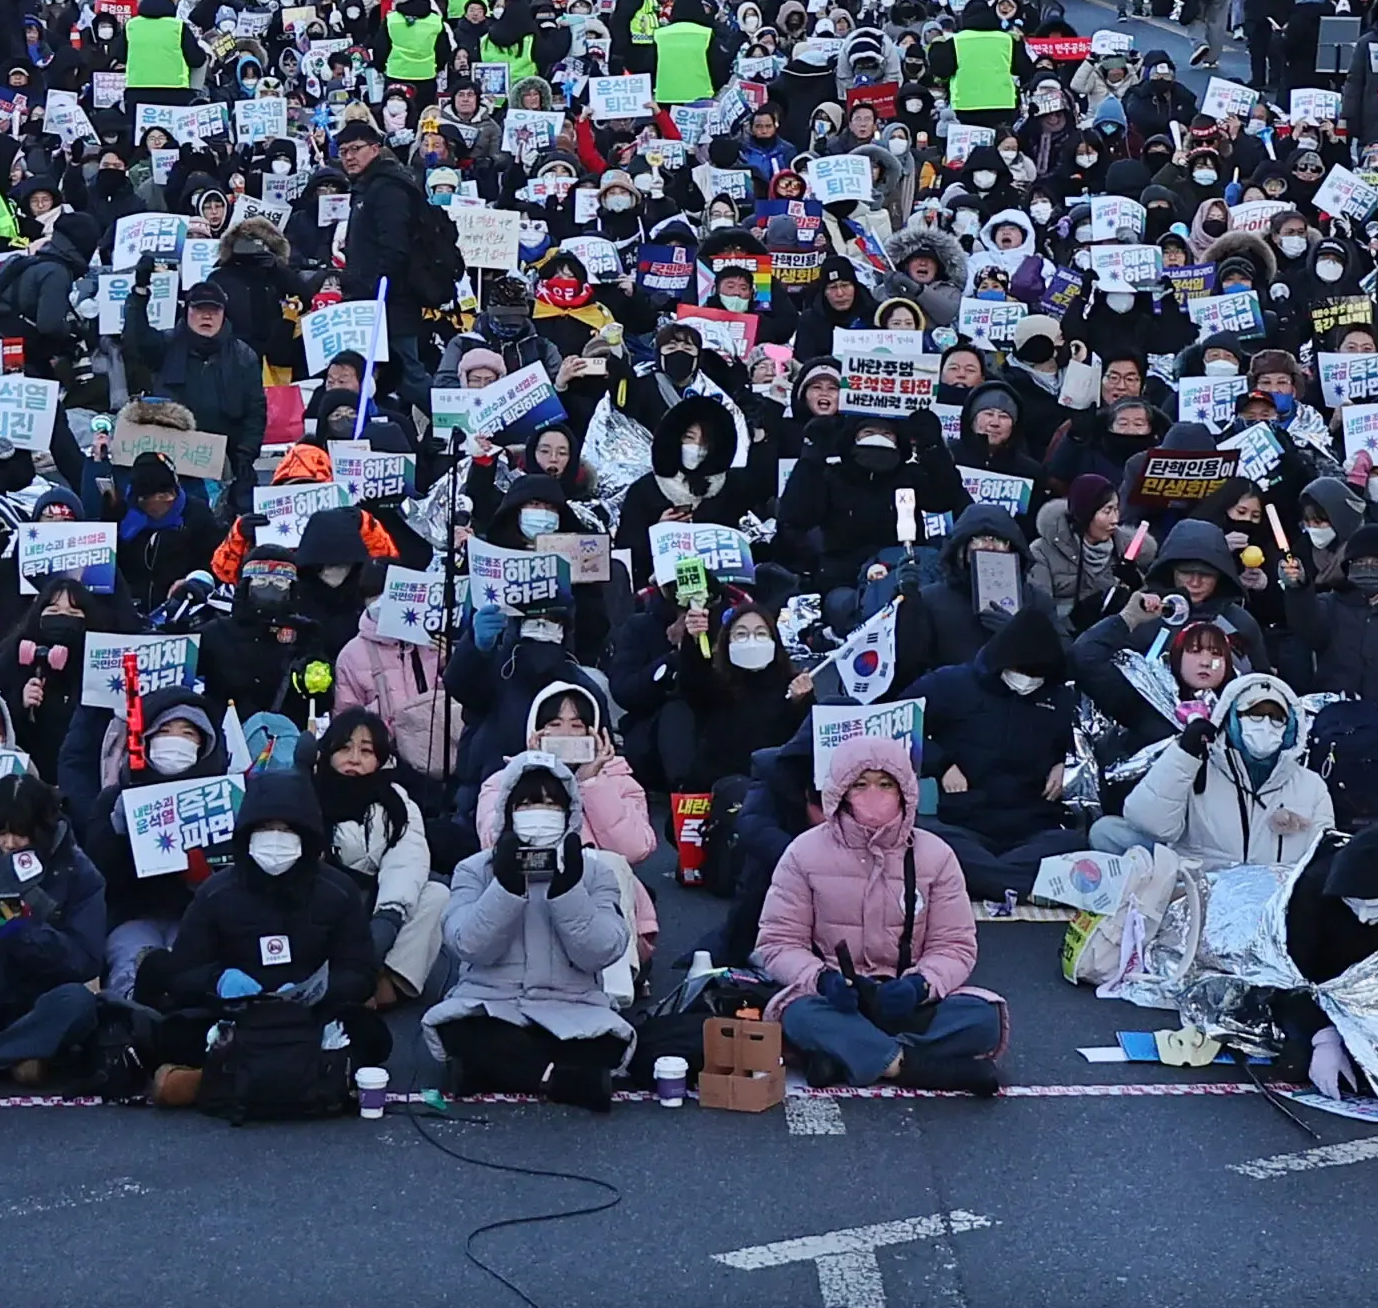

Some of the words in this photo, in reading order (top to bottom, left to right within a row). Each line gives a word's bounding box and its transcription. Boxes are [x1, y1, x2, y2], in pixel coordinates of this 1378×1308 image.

[595, 78, 644, 95] 윤석열
[604, 95, 637, 114] 퇴진
[815, 160, 865, 179] 윤석열
[826, 177, 860, 196] 퇴진
[143, 217, 178, 239] 즉각
[140, 236, 174, 253] 파면
[1122, 249, 1156, 267] 해체
[1123, 266, 1160, 284] 하라
[992, 306, 1024, 325] 즉각
[1220, 298, 1255, 318] 즉각
[310, 305, 377, 338] 윤석열
[1223, 312, 1256, 334] 파면
[322, 335, 368, 365] 퇴진
[849, 358, 913, 377] 내란주범
[847, 376, 896, 395] 윤석열
[900, 378, 931, 396] 퇴진
[501, 384, 551, 425] 퇴진하라!
[363, 457, 405, 480] 해체
[1149, 458, 1236, 477] 탄핵인용이
[294, 485, 339, 513] 해체
[365, 479, 405, 501] 하라
[979, 477, 1021, 499] 해체
[24, 541, 63, 557] 내란수괴
[67, 532, 106, 548] 윤석열은
[692, 527, 739, 551] 즉각
[22, 559, 49, 577] 즉각
[52, 548, 110, 575] 퇴진하라!
[502, 554, 557, 581] 해체
[699, 548, 743, 570] 파면
[389, 580, 427, 594] 내란동조
[389, 591, 427, 604] 국민의힘
[503, 575, 558, 605] 하라
[136, 638, 187, 669] 해체
[819, 719, 863, 736] 내란동조
[864, 703, 916, 741] 해체
[132, 796, 174, 819] 내란수괴
[176, 779, 233, 815] 즉각
[136, 808, 176, 834] 윤석열
[180, 812, 236, 851] 파면
